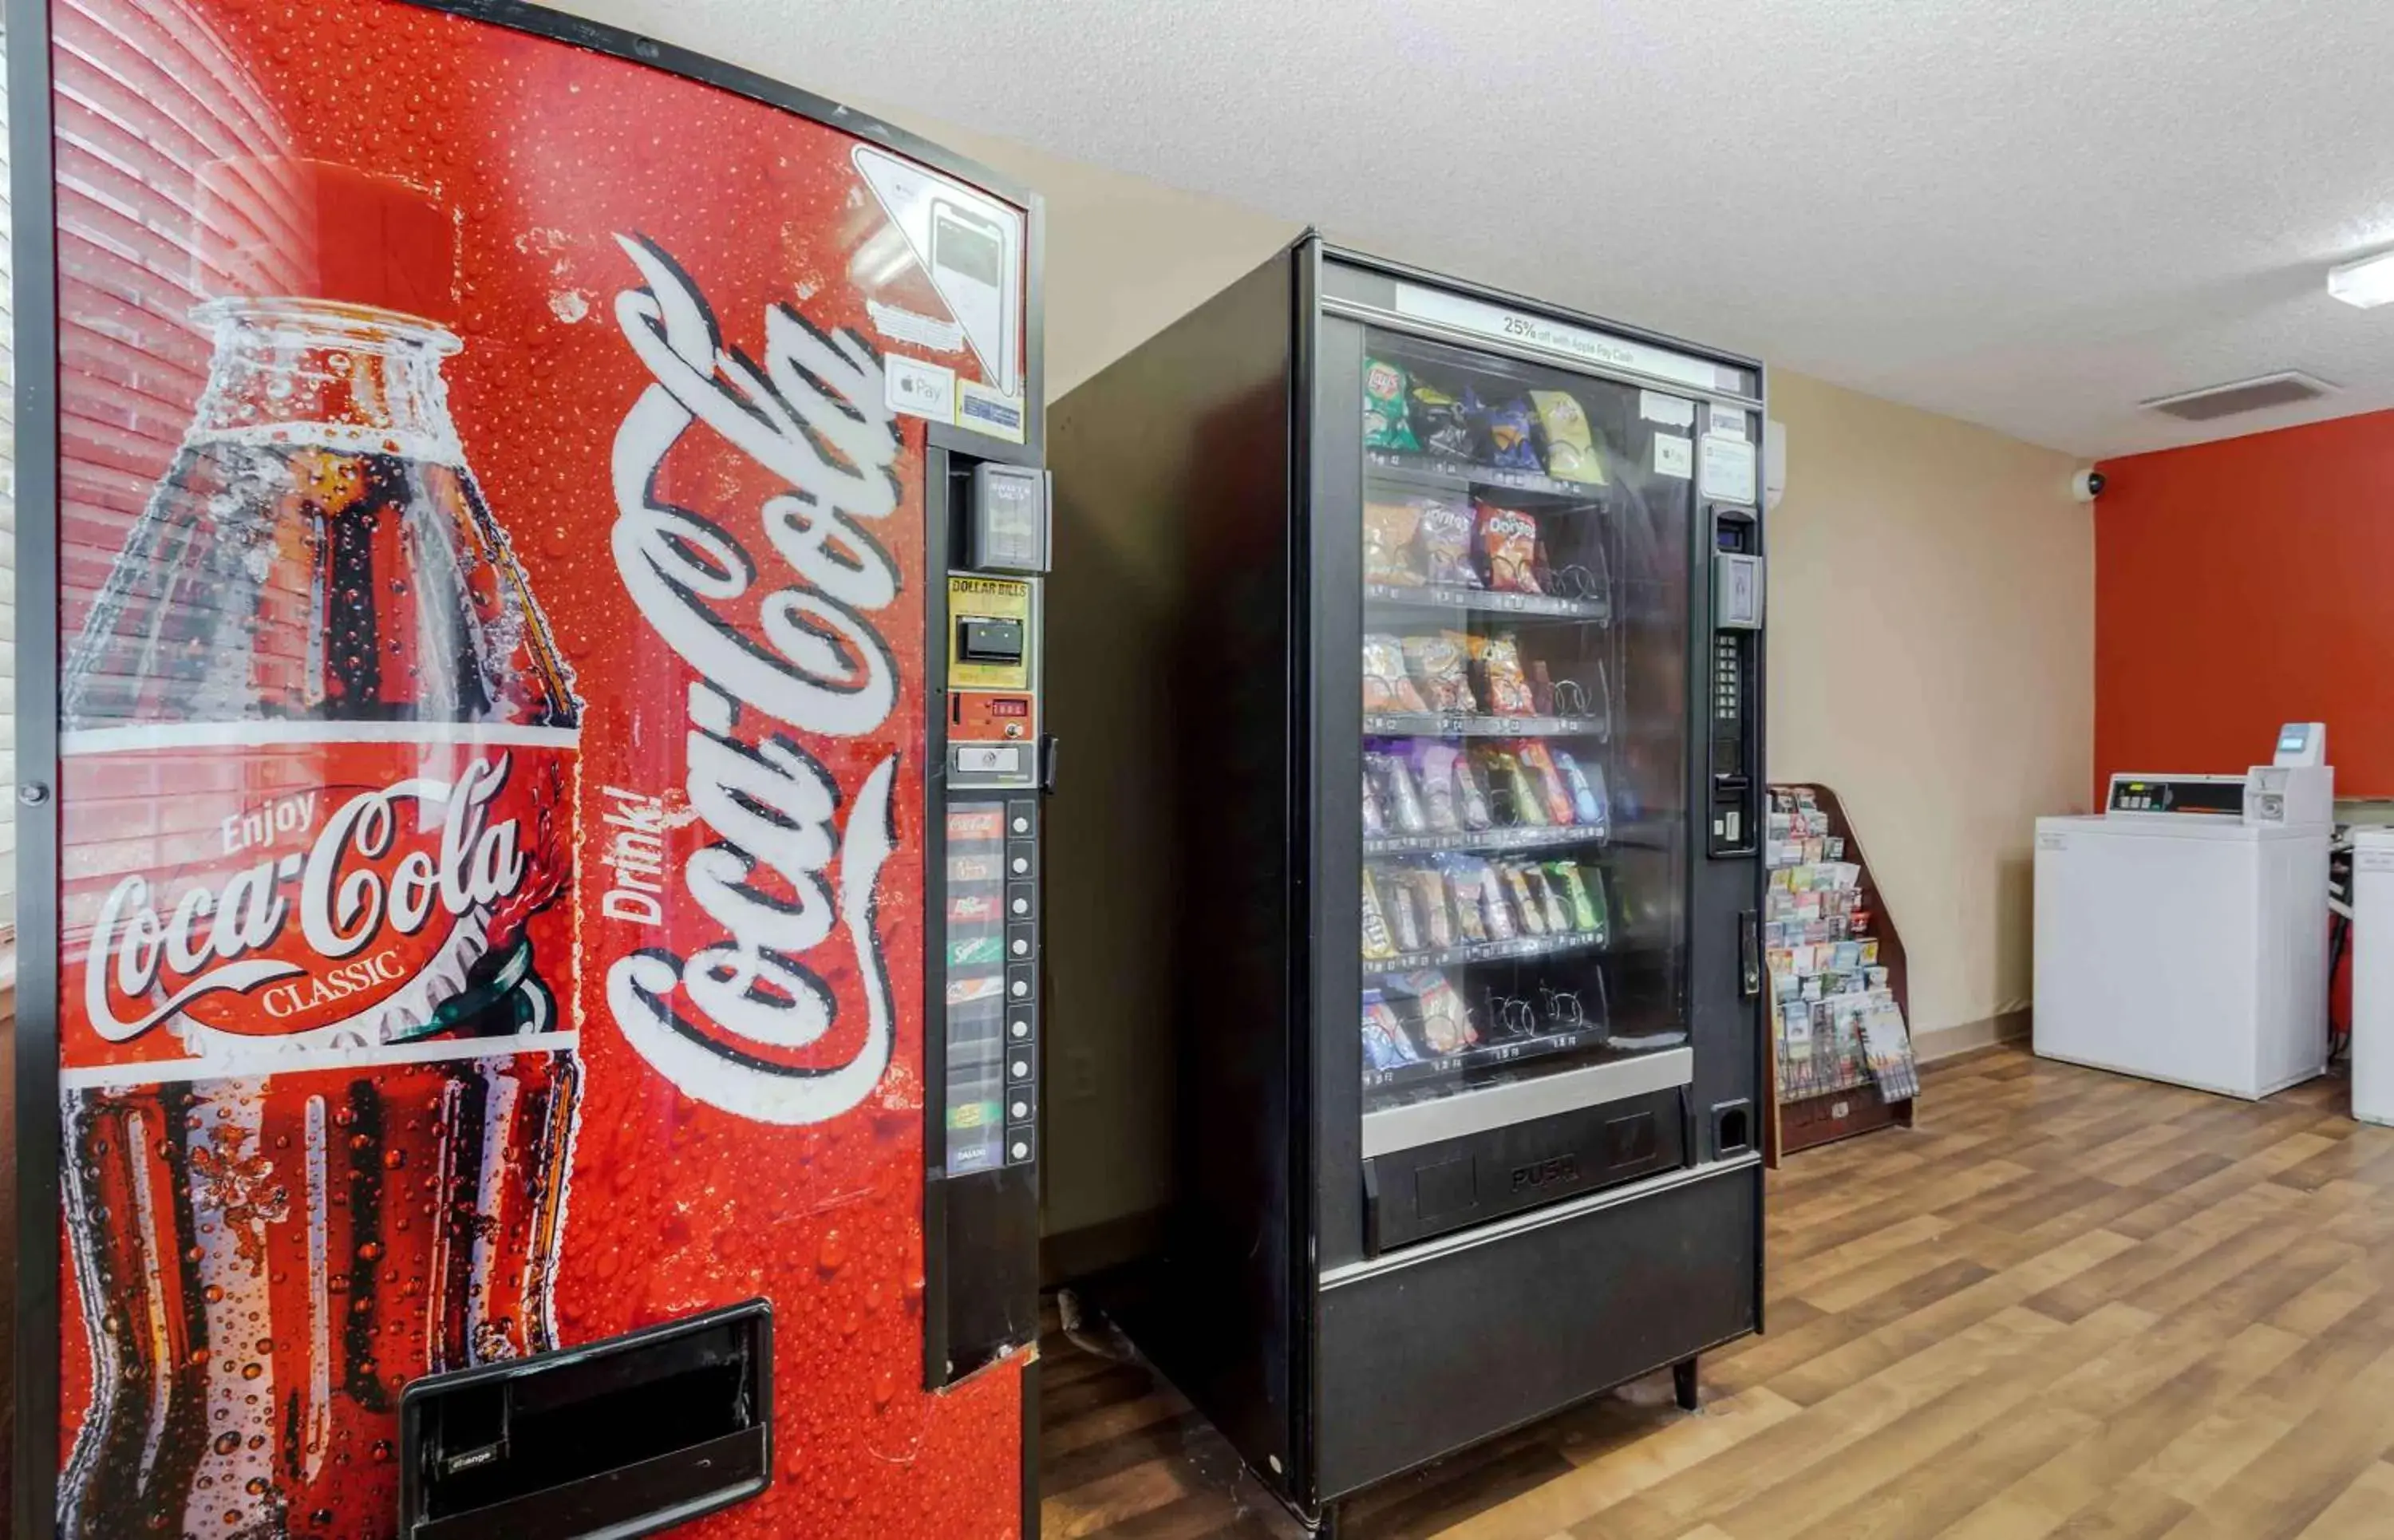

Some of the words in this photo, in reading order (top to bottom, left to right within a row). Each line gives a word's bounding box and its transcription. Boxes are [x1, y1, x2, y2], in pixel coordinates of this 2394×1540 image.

[1504, 316, 1536, 338] 25%
[917, 378, 942, 403] Pay
[953, 580, 995, 594] DOLLAR
[998, 583, 1026, 598] BILLS
[608, 231, 902, 1126] Coca-Cola
[221, 792, 316, 856] Enjoy
[602, 785, 662, 926] Drink!
[86, 748, 523, 1042] Coca-Cola
[263, 950, 405, 1017] CLASSIC
[1511, 1154, 1578, 1192] PUSH
